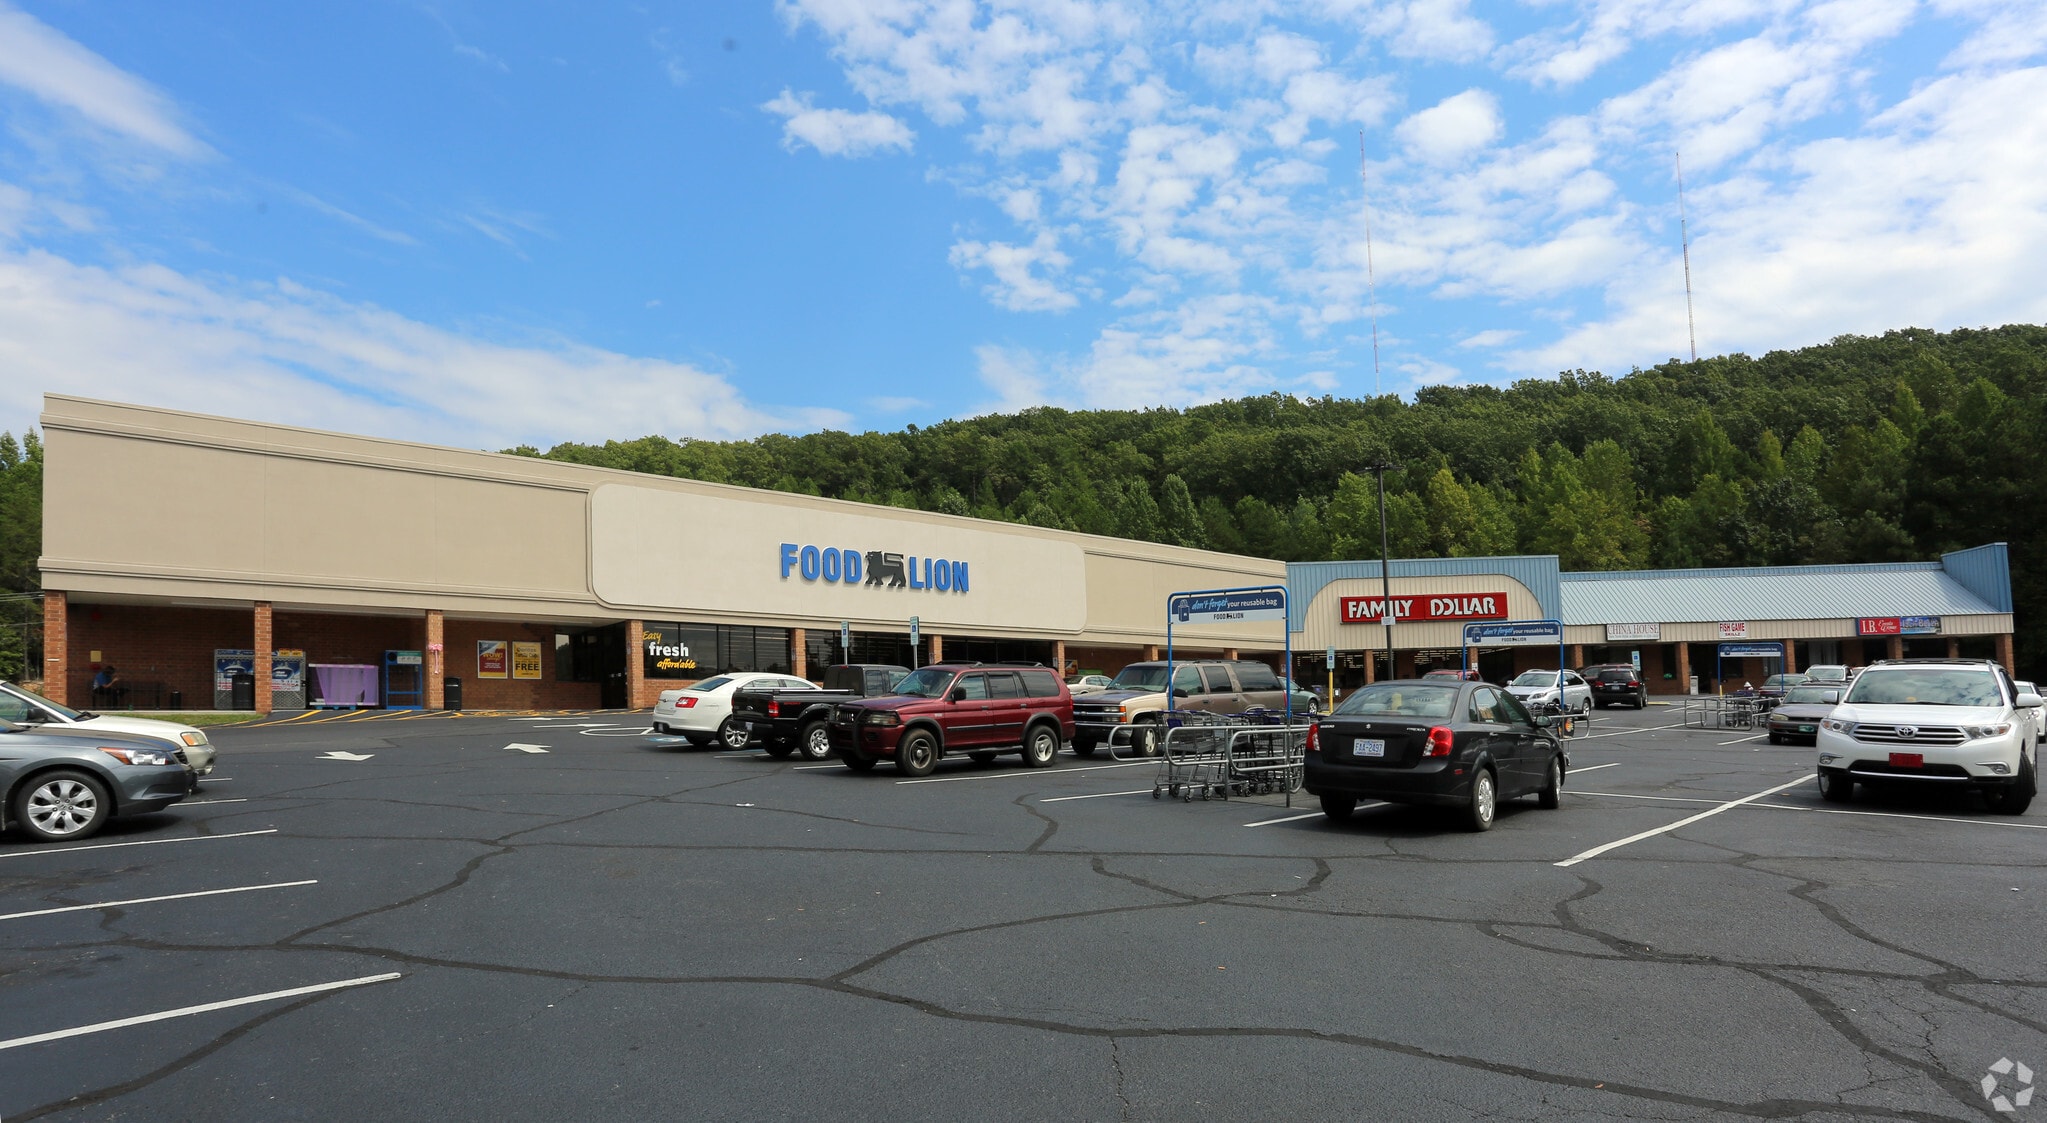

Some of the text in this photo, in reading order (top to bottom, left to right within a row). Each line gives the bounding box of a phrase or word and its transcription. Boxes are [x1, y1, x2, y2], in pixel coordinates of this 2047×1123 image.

[780, 543, 969, 593] FOOD LION
[1192, 600, 1207, 610] don't
[1207, 598, 1227, 611] forget
[1266, 598, 1278, 606] bag
[1348, 597, 1496, 618] FAMILY DOLLAR
[1497, 627, 1513, 635] forget
[1608, 624, 1659, 634] CHINA HOUSE
[1720, 622, 1744, 632] FISH GAME
[1862, 620, 1877, 633] I.B.
[642, 631, 662, 644] Easy
[649, 641, 689, 657] fresh
[656, 658, 696, 670] affordable
[1355, 743, 1382, 752] FAA-2497
